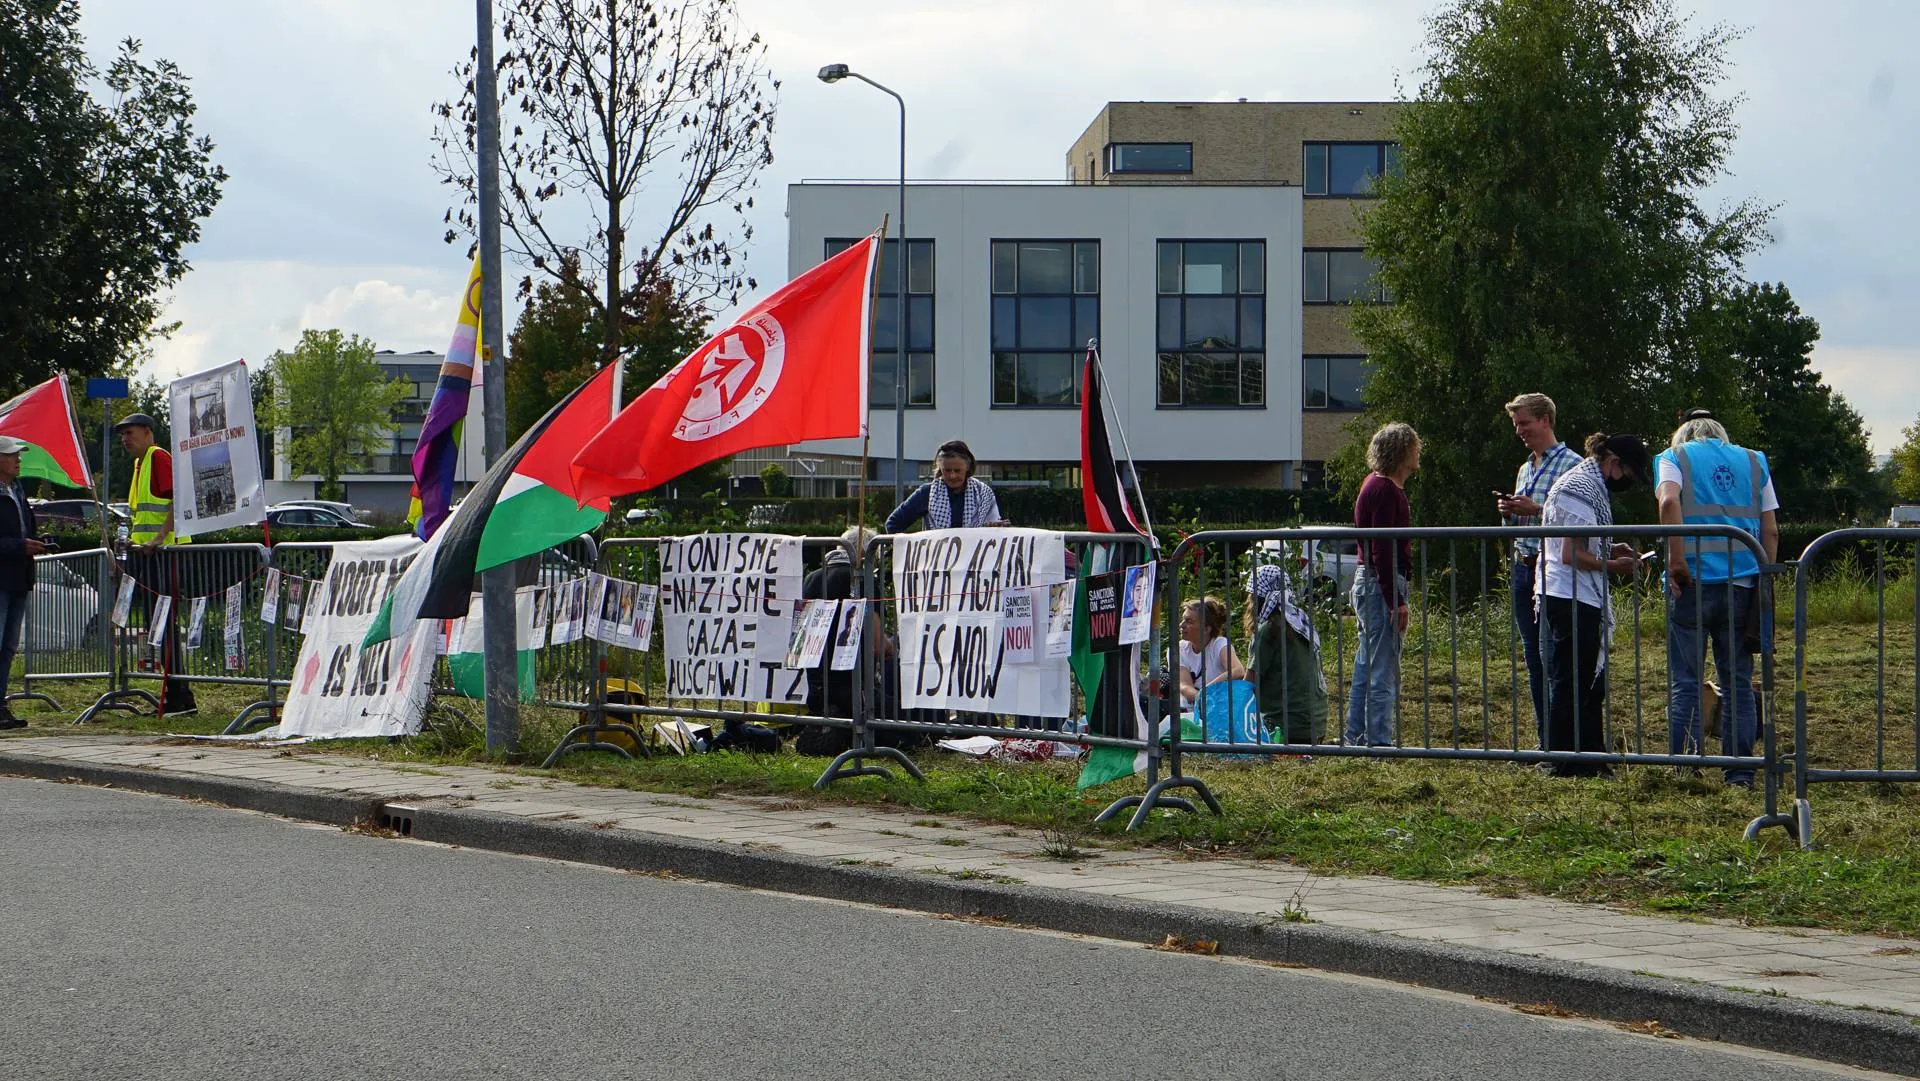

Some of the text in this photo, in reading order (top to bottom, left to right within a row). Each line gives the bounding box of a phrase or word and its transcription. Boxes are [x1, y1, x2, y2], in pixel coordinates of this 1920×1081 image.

[901, 536, 962, 614] NEVER
[1005, 608, 1014, 618] ON
[321, 643, 352, 697] IS
[947, 625, 1005, 699] NOW
